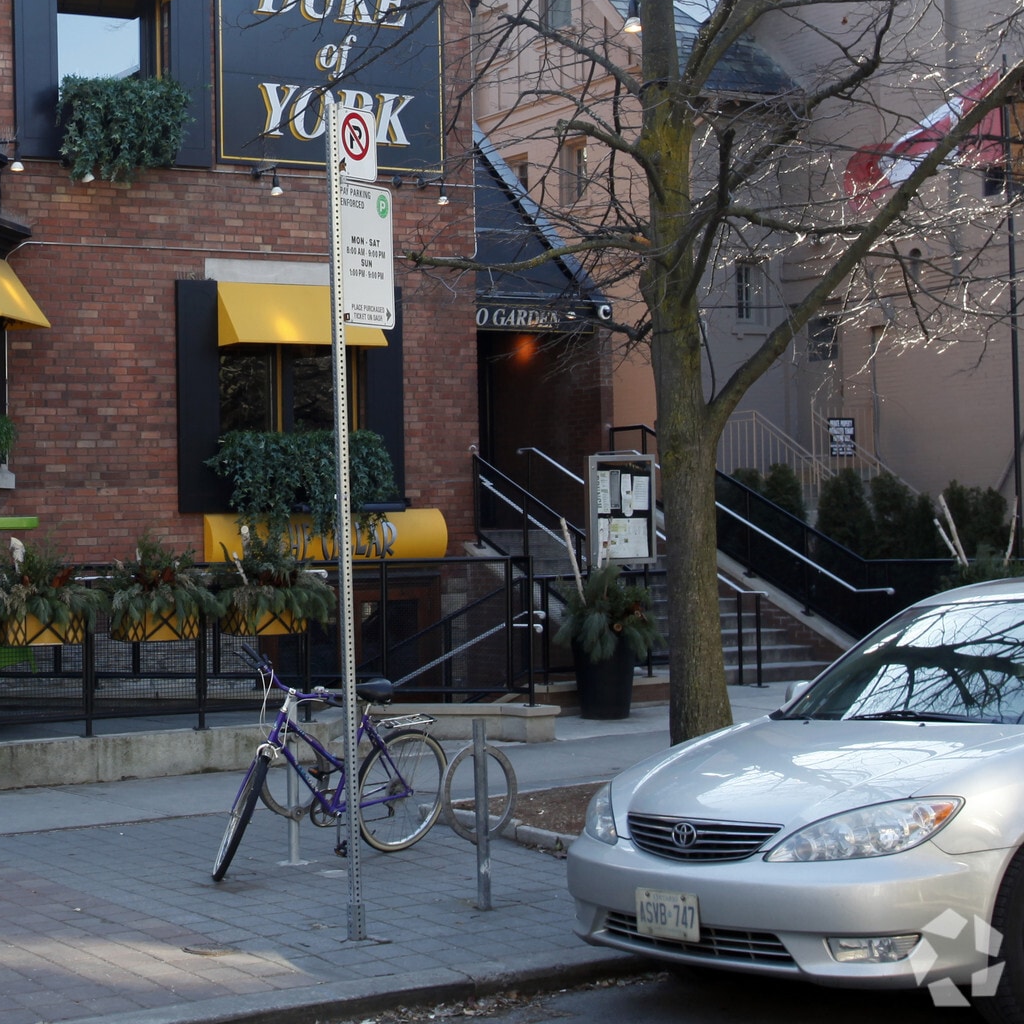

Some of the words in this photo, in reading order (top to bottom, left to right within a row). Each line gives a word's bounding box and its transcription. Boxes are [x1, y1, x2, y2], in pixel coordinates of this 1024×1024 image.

[314, 34, 358, 82] of
[340, 186, 349, 196] PAY
[350, 188, 372, 200] PARKING
[340, 197, 365, 209] ENFORCED
[351, 236, 365, 245] MON
[369, 238, 380, 247] SAT
[361, 259, 373, 268] SUN
[640, 900, 668, 926] ASVB
[673, 904, 695, 929] 747
